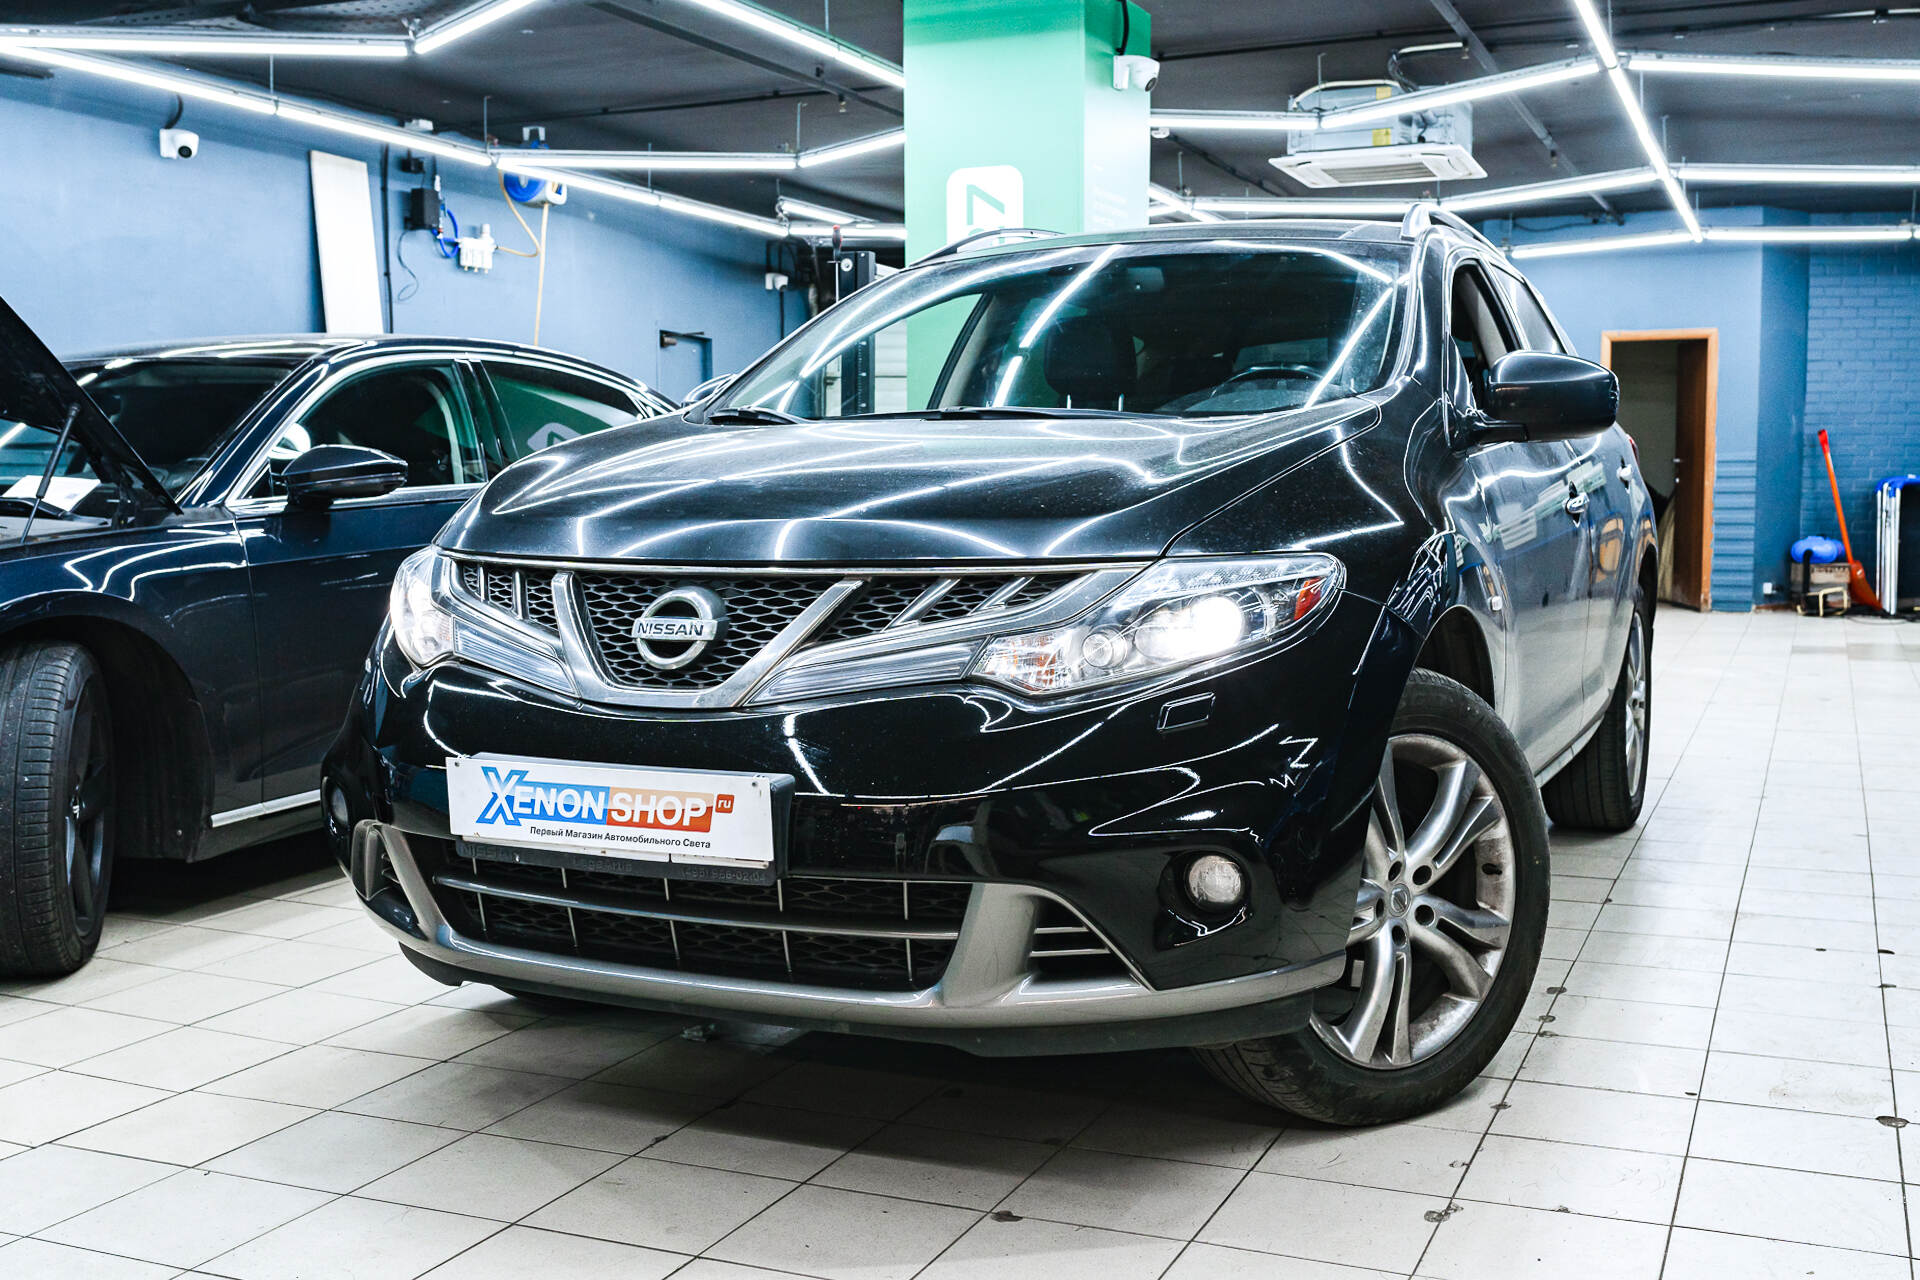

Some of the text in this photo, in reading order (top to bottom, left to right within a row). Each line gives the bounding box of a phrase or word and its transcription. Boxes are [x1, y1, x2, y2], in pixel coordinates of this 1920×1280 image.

[637, 622, 704, 636] NISSAN
[530, 827, 711, 849] Первый Магазин Автомобильного Света
